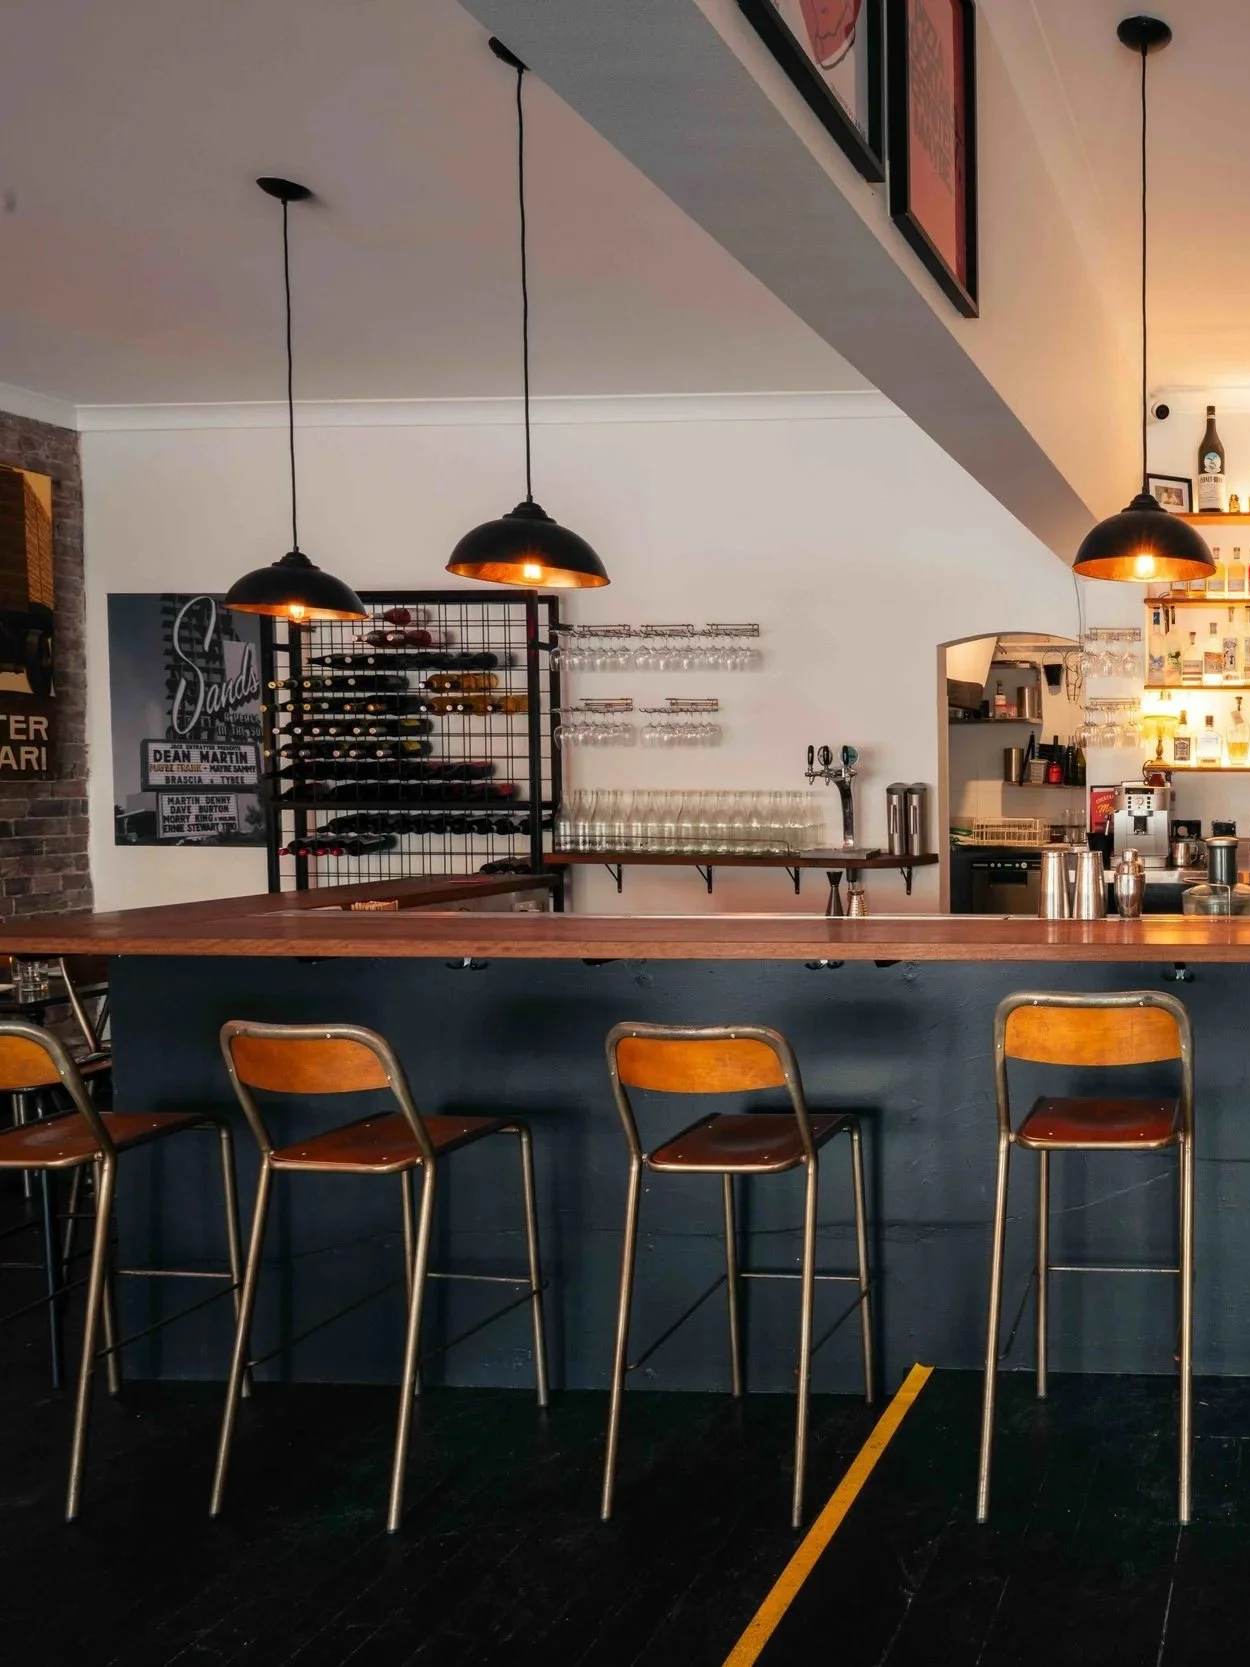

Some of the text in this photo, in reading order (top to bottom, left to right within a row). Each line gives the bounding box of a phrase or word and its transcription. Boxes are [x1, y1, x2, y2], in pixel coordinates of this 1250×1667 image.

[173, 596, 259, 734] Sands
[0, 745, 47, 771] ARI
[153, 749, 248, 764] DEAN MARTIN
[209, 765, 232, 773] MAYBE
[232, 765, 256, 774] SAMMY
[165, 775, 203, 784] BRASCIA
[167, 796, 231, 806] MARTIN DENNY
[170, 804, 229, 814] DAVE BURTON
[163, 814, 190, 824] MORRY
[195, 813, 214, 823] KING
[186, 822, 220, 833] STEWART
